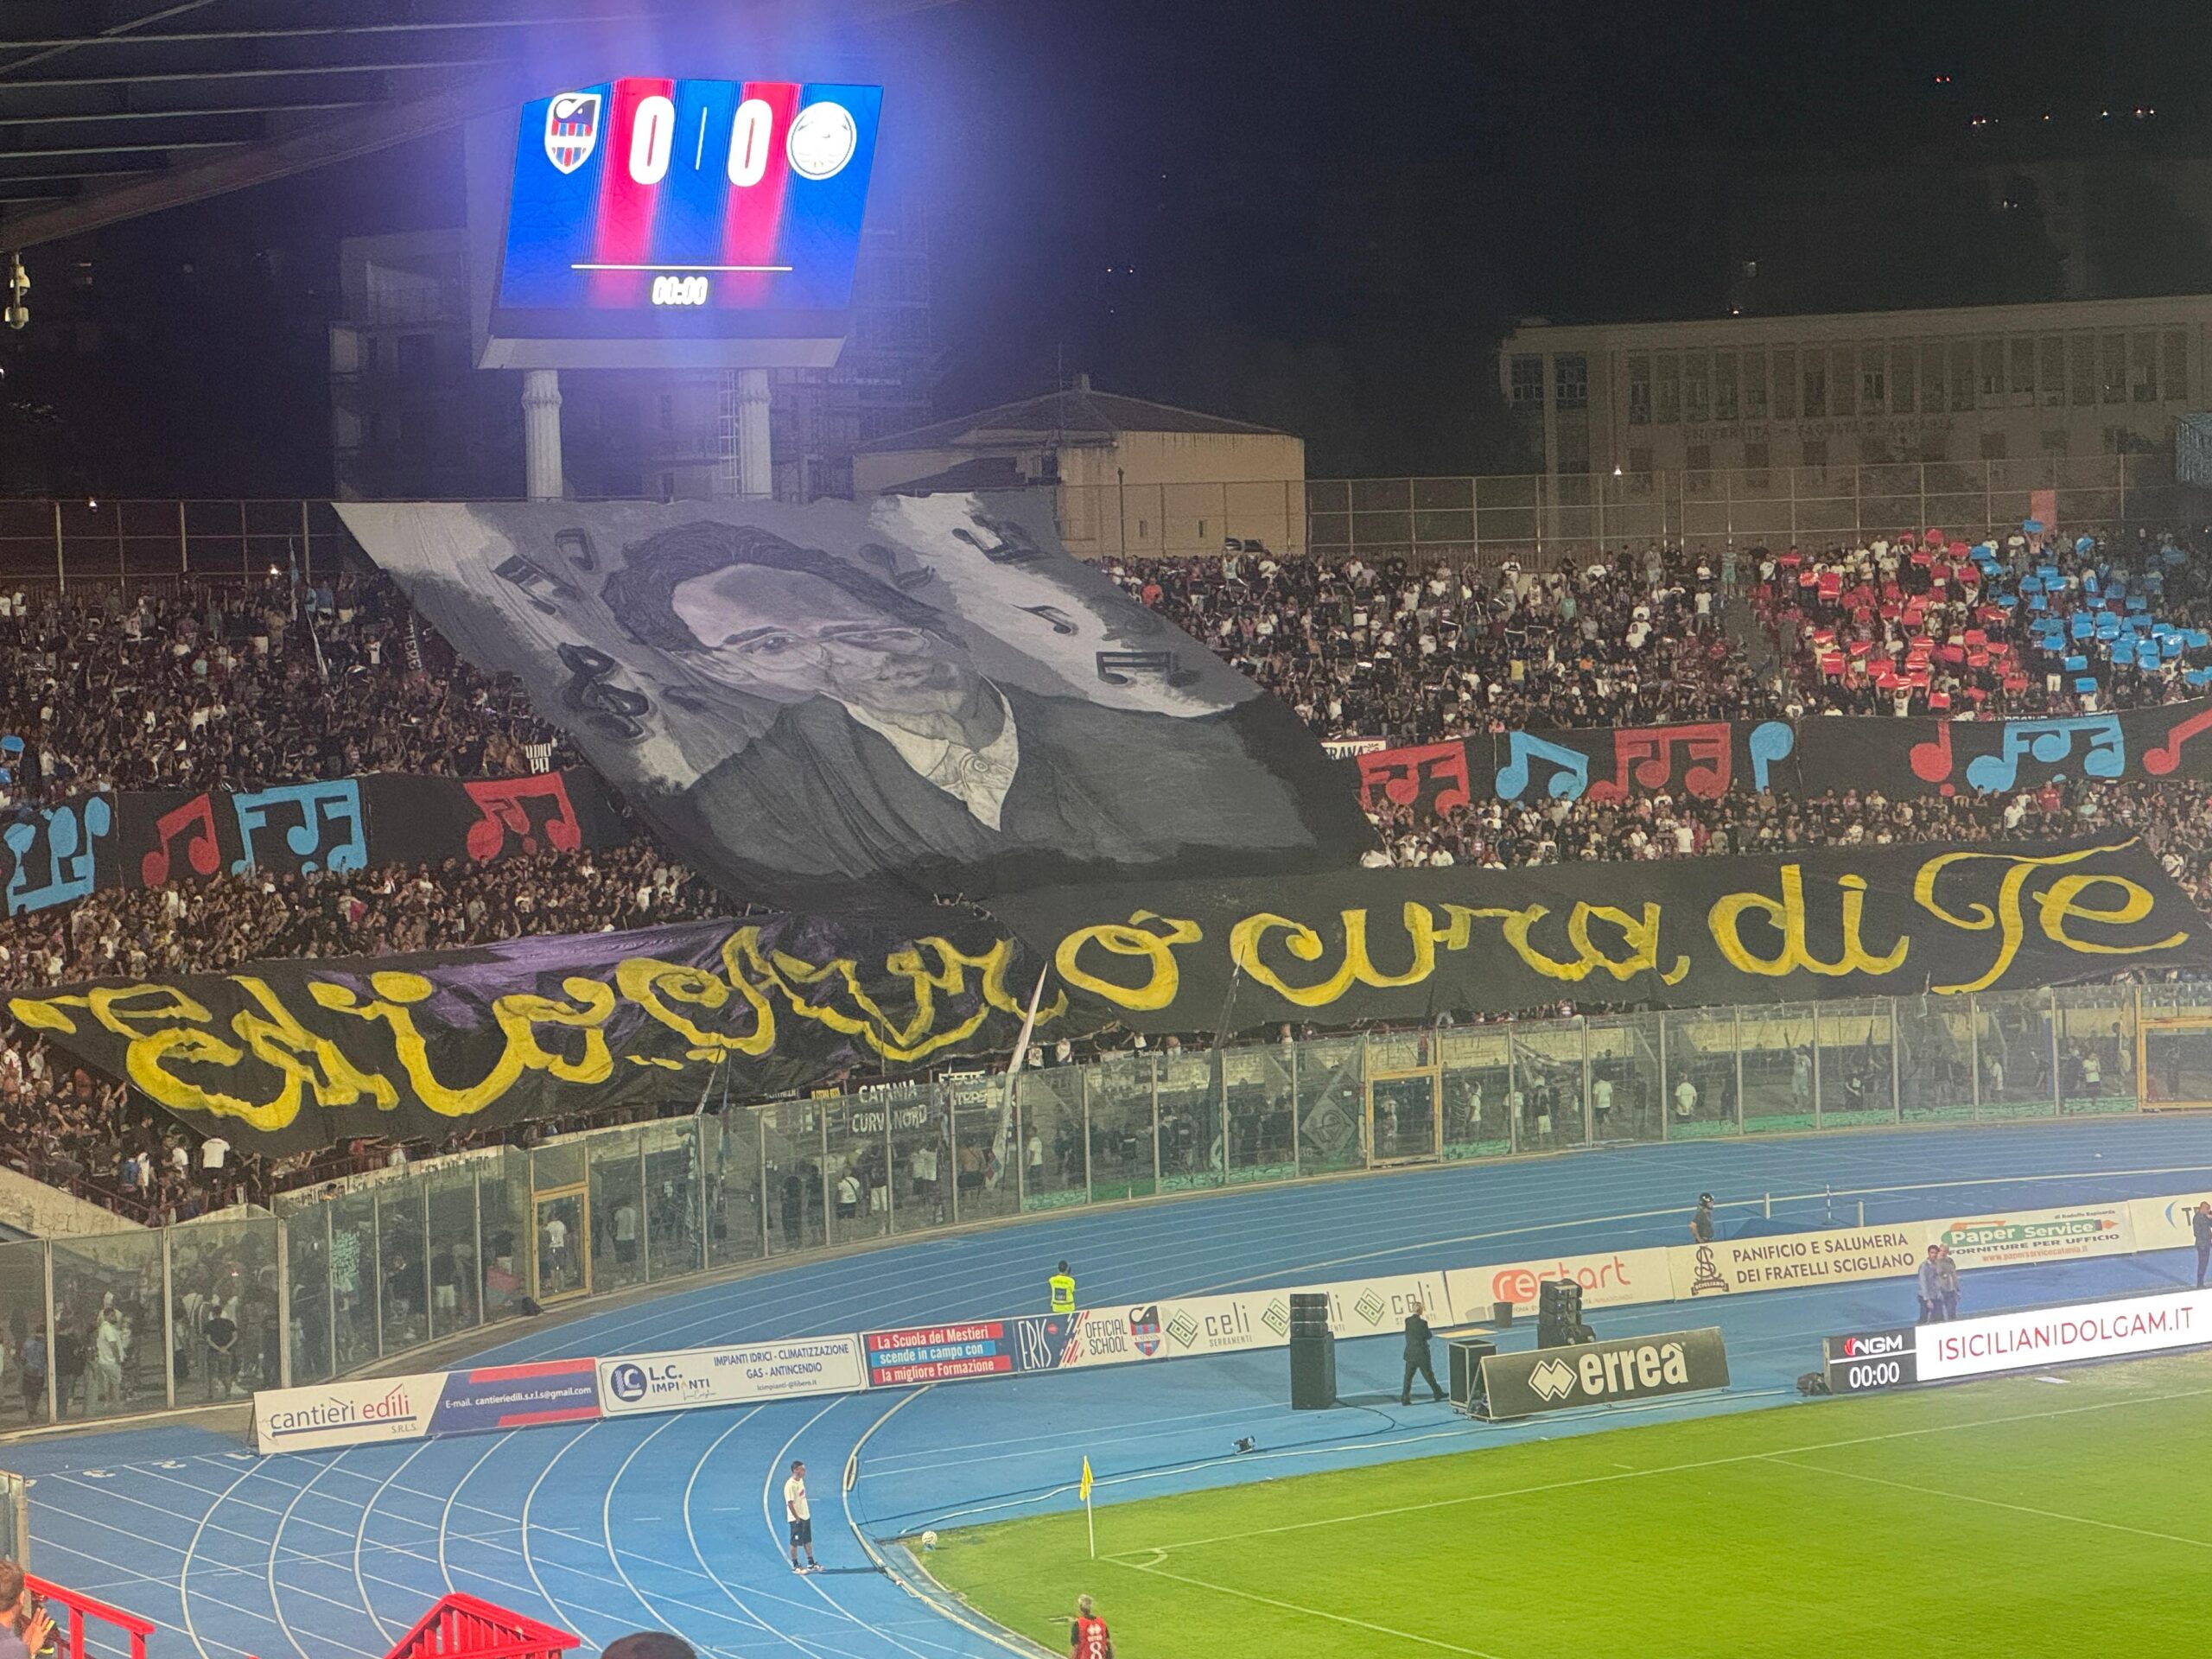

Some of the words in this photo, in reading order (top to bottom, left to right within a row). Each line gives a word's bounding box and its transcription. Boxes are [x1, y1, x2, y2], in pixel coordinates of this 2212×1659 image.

[629, 96, 675, 185] 0
[728, 99, 773, 188] 0
[652, 276, 709, 305] 00:00
[1230, 901, 1691, 1007] cura
[1708, 864, 1910, 976] di
[1913, 836, 2189, 995] Te
[1948, 1242, 2029, 1255] FORNITURE
[2032, 1239, 2061, 1248] PER
[2065, 1234, 2120, 1244] UFFICIO
[1950, 1227, 2016, 1245] Paper
[2024, 1222, 2094, 1238] Service
[1732, 1243, 1807, 1263] PANIFICIO
[1811, 1243, 1821, 1255] E
[1824, 1233, 1909, 1254] SALUMERIA
[1736, 1268, 1761, 1284] DEI
[1764, 1262, 1829, 1281] FRATELLI
[1833, 1253, 1915, 1274] SCIGLIANO
[1085, 1319, 1128, 1339] OFFICIAL
[1205, 1301, 1250, 1337] celi
[877, 1336, 891, 1350] La
[893, 1332, 927, 1349] Scuola
[929, 1331, 944, 1344] dei
[946, 1325, 989, 1341] Mestieri
[1018, 1319, 1052, 1370] ERIS
[1090, 1336, 1128, 1356] SCHOOL
[1938, 1306, 2194, 1362] ISICILIANIDOLGAM.IT
[714, 1353, 748, 1366] IMPIANTI
[750, 1351, 772, 1363] IDRICI
[779, 1344, 849, 1360] CLIMATIZZAZIONE
[880, 1349, 916, 1365] scende
[918, 1347, 927, 1361] in
[930, 1345, 963, 1360] campo
[965, 1344, 983, 1356] con
[648, 1365, 683, 1381] L.C.
[746, 1369, 763, 1379] GAS
[770, 1363, 823, 1376] ANTINCENDIO
[881, 1369, 892, 1382] la
[894, 1363, 938, 1382] migliore
[938, 1359, 995, 1376] Formazione
[1849, 1361, 1900, 1389] 00:00
[270, 1399, 356, 1430] cantieri
[362, 1389, 410, 1420] edili
